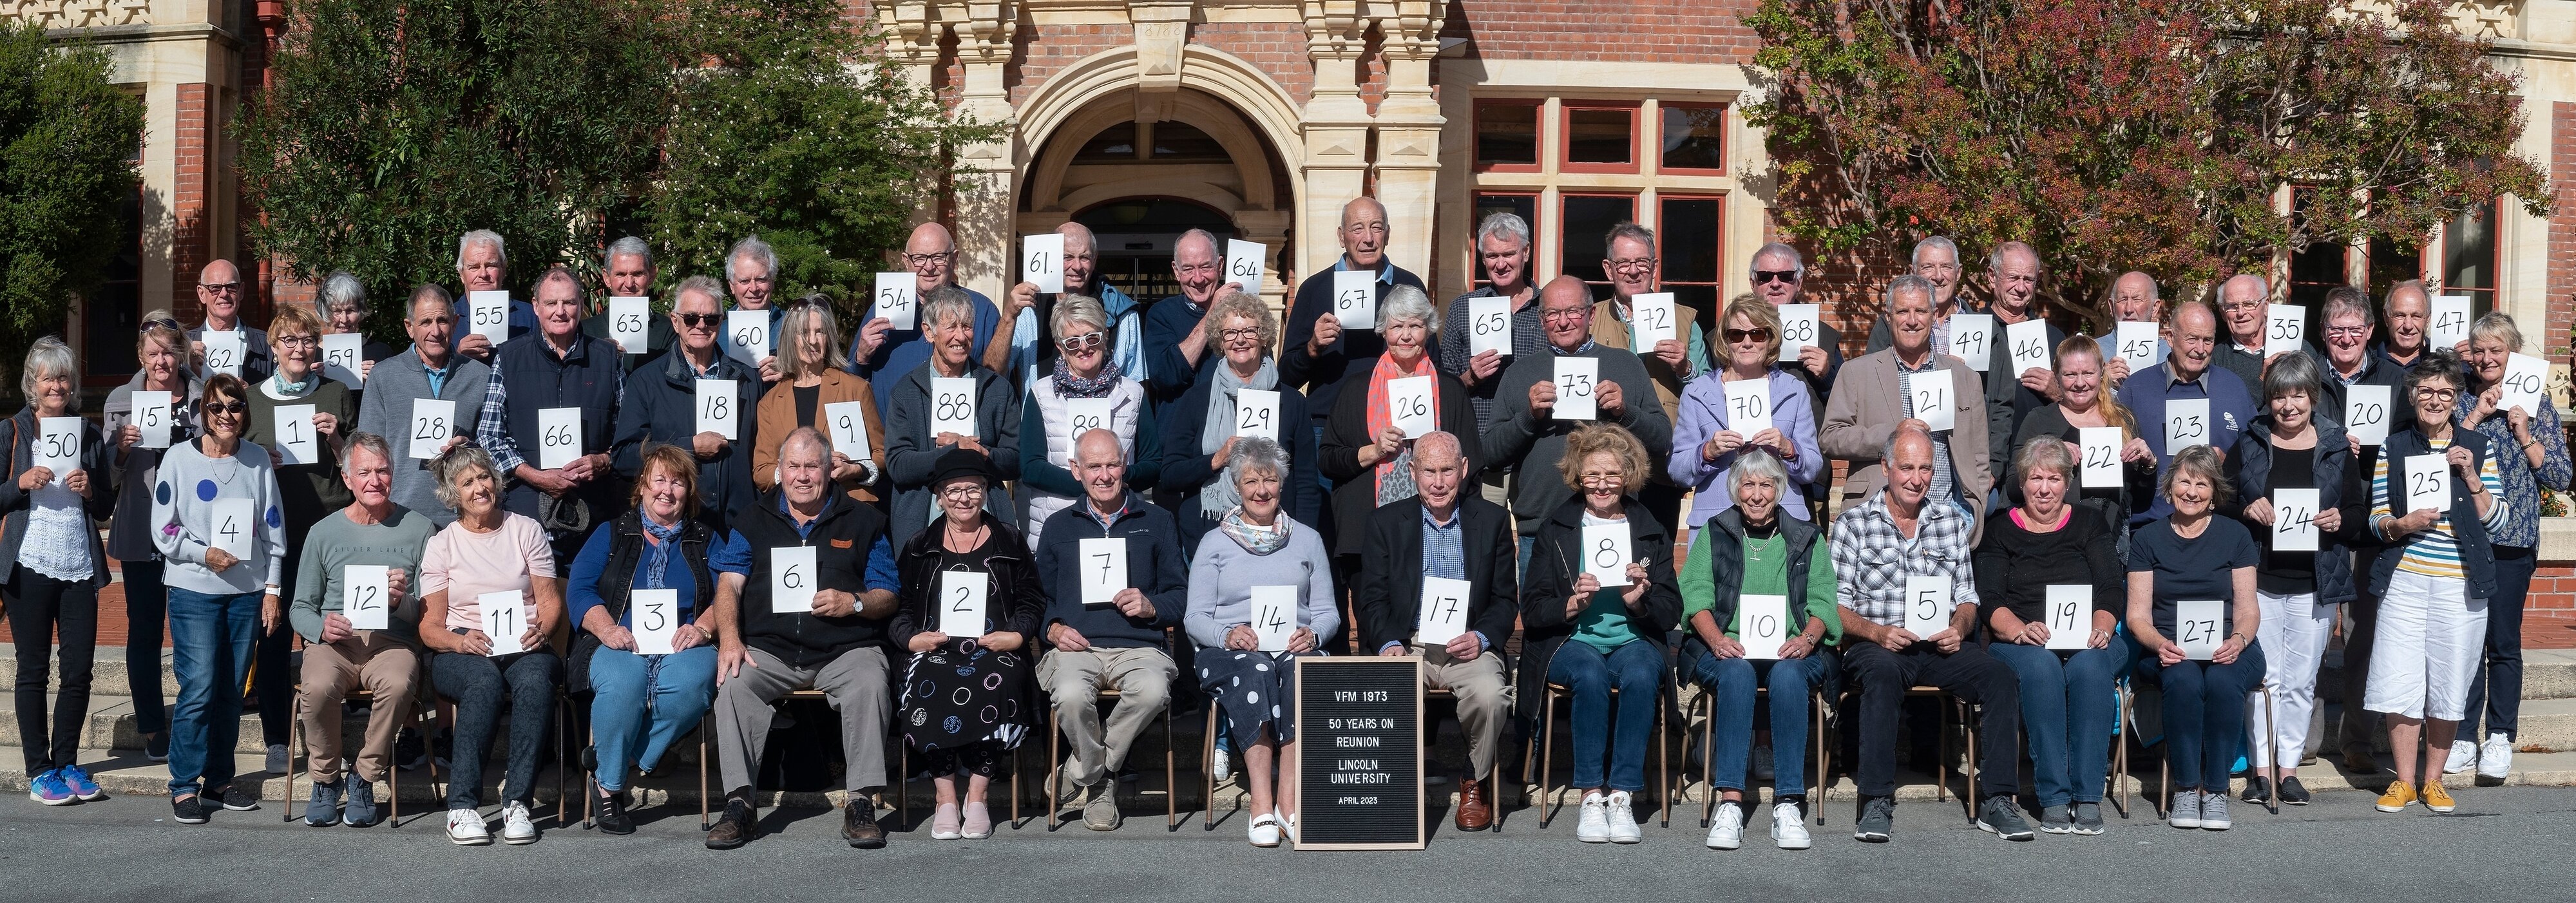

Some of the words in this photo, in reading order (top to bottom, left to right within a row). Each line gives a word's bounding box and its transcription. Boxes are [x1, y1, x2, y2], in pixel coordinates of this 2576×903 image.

[1233, 257, 1258, 281] 64
[881, 287, 910, 312] 54
[1339, 289, 1368, 310] 67
[475, 306, 503, 326] 55
[616, 313, 642, 333] 63
[1476, 312, 1505, 336] 65
[1641, 307, 1670, 331] 72
[2436, 311, 2465, 335] 47
[736, 327, 762, 347] 60
[1783, 319, 1813, 341] 68
[2271, 318, 2300, 340] 35
[1956, 330, 1983, 355] 49
[2016, 337, 2043, 361] 46
[2123, 339, 2153, 359] 45
[208, 348, 234, 368] 62
[329, 348, 353, 368] 59
[1561, 374, 1591, 397] 73
[2505, 372, 2540, 394] 40
[705, 395, 728, 420] 18
[937, 392, 971, 421] 88
[1398, 394, 1427, 420] 26
[1732, 395, 1762, 419] 70
[1920, 388, 1942, 413] 21
[139, 406, 166, 430] 15
[1241, 406, 1270, 430] 29
[2351, 403, 2383, 427] 20
[287, 419, 306, 445] 1
[415, 417, 446, 440] 28
[2173, 415, 2203, 440] 23
[46, 432, 77, 459] 30
[2086, 445, 2114, 468] 22
[2412, 470, 2444, 497] 25
[220, 515, 240, 544] 4
[2279, 506, 2314, 534] 24
[1595, 538, 1619, 569] 8
[1092, 553, 1111, 585] 7
[353, 585, 381, 611] 12
[953, 586, 973, 613] 2
[1429, 596, 1458, 624] 17
[1917, 590, 1937, 621] 5
[491, 607, 513, 637] 11
[644, 603, 665, 631] 3
[1259, 604, 1286, 634] 14
[1749, 614, 1776, 638] 10
[2054, 602, 2077, 631] 19
[2184, 620, 2215, 645] 27
[1335, 690, 1357, 702] VFM
[1363, 691, 1388, 702] 1973
[1329, 718, 1341, 729] 50
[1346, 718, 1377, 729] YEARS
[1381, 718, 1393, 729] ON
[1337, 736, 1379, 747] REUNION
[1339, 759, 1378, 770] LINCOLN
[1331, 773, 1391, 784] UNIVERSITY
